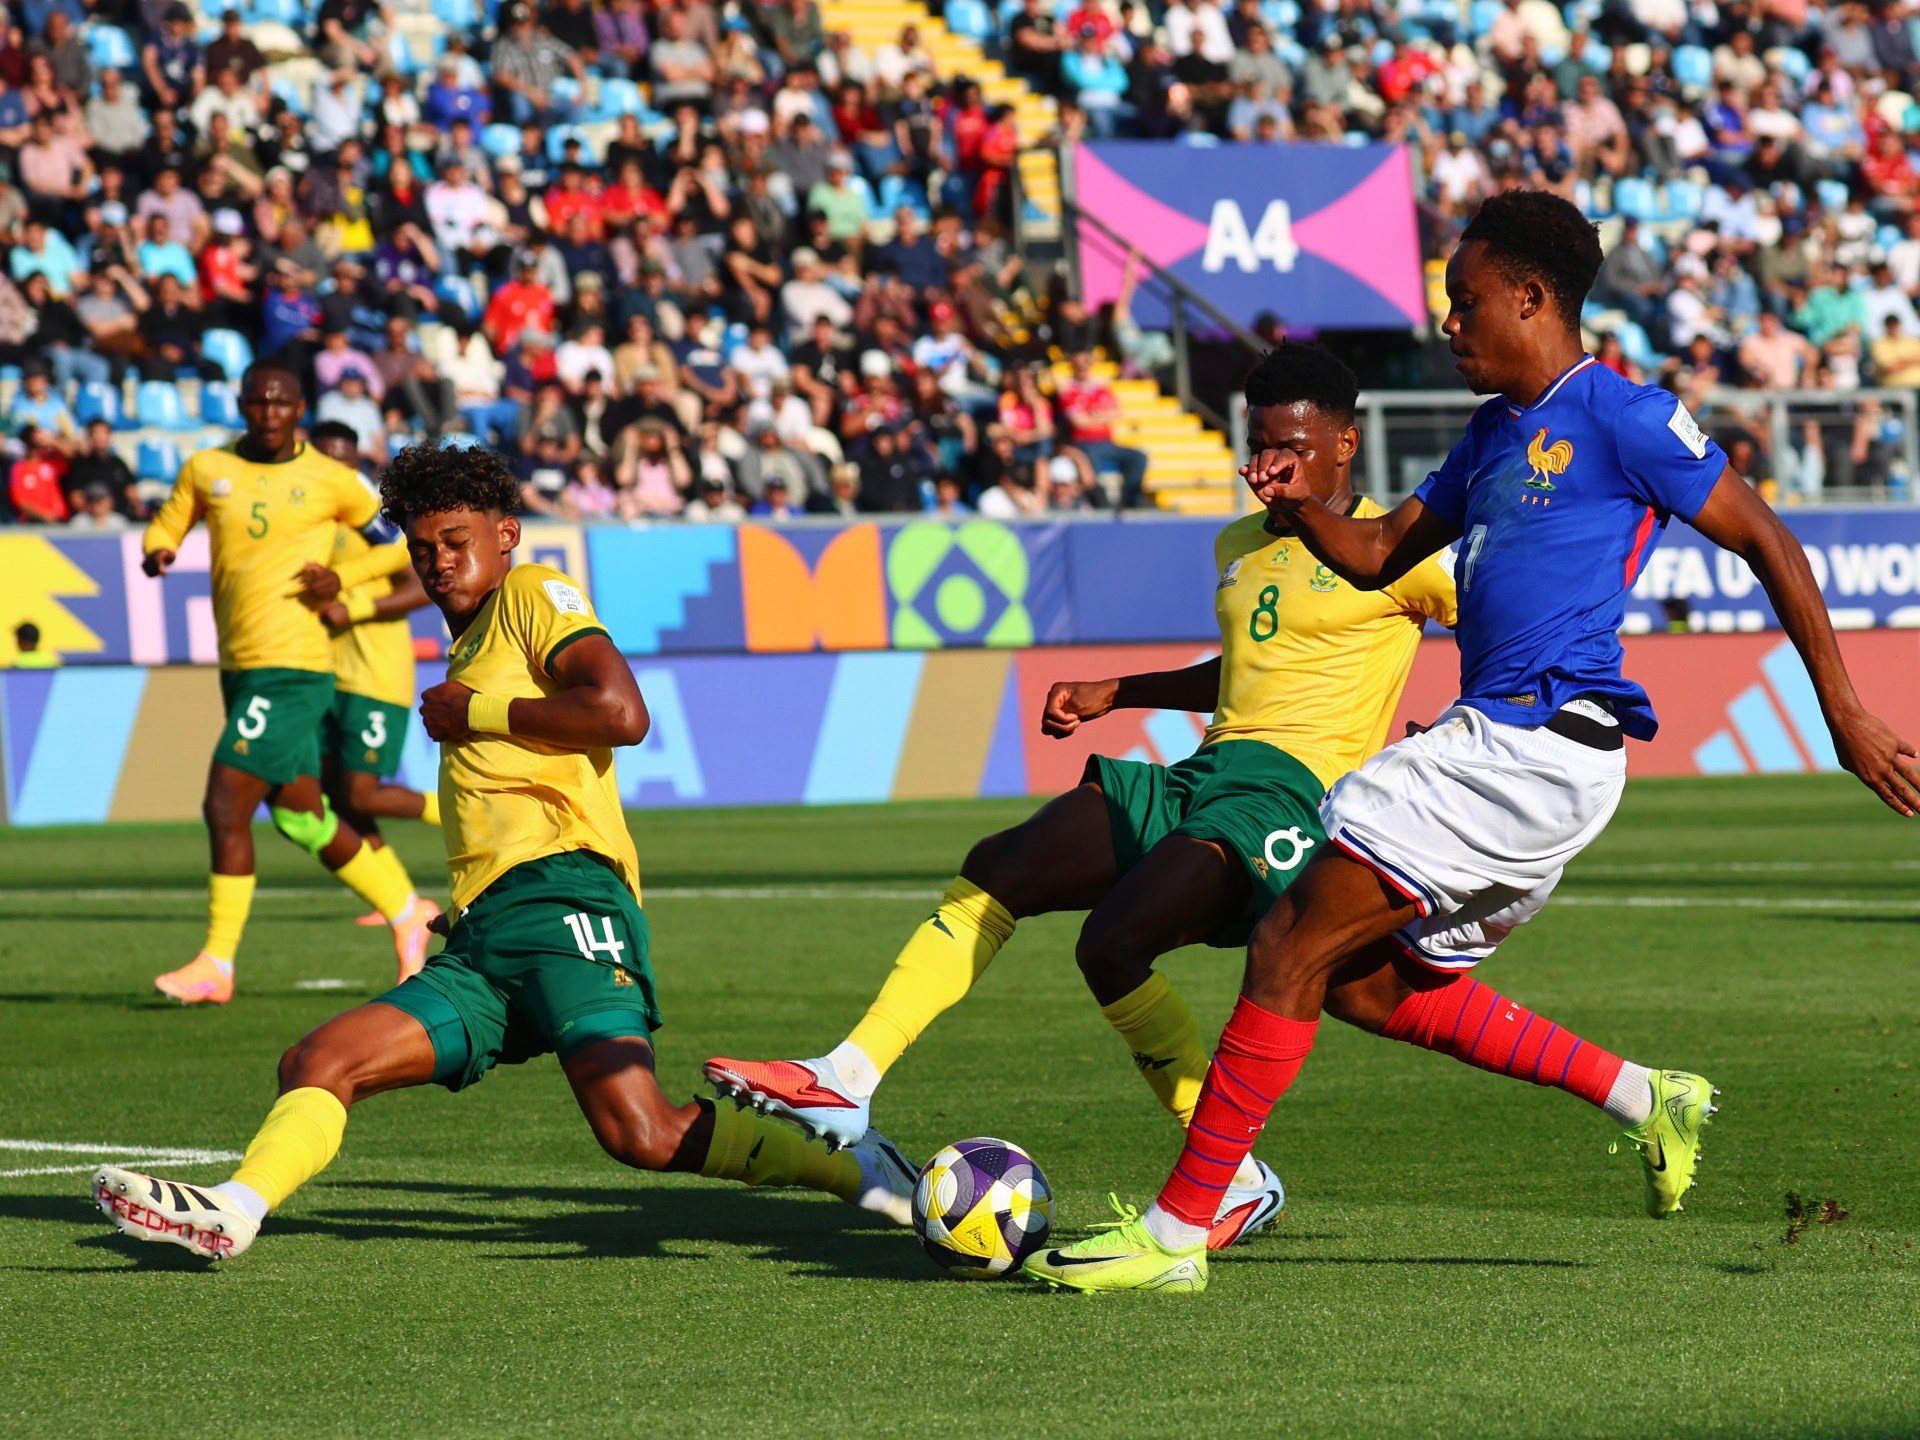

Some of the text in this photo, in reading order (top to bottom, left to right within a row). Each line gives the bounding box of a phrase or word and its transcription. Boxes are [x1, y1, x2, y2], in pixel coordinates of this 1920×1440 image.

[1202, 199, 1299, 273] A4
[247, 502, 269, 539] 5
[1632, 548, 1714, 599] IFA
[1829, 543, 1920, 597] WO
[1250, 584, 1280, 642] 8
[237, 694, 272, 740] 5
[361, 711, 387, 749] 3
[562, 912, 625, 964] 14
[98, 1185, 235, 1258] PREDATOR
